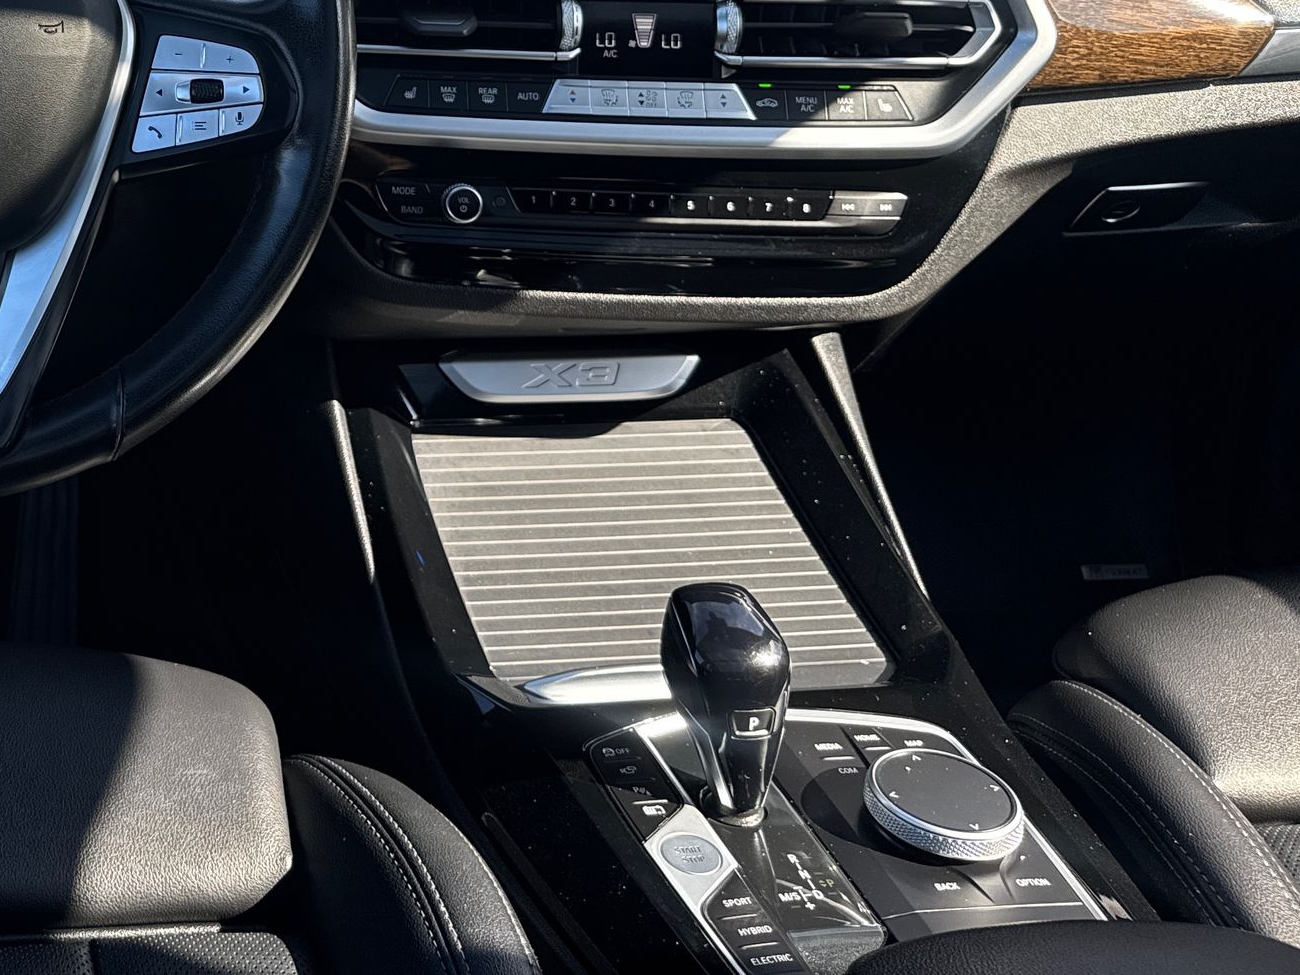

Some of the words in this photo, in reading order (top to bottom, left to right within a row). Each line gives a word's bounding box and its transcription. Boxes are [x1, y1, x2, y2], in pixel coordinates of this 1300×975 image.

[595, 32, 615, 47] LO
[661, 33, 681, 49] LO
[603, 49, 618, 58] A/C
[440, 85, 457, 94] MAX
[478, 87, 498, 95] REAR
[517, 91, 540, 101] AUTO
[795, 96, 818, 105] MENU
[836, 97, 854, 105] MAX
[800, 104, 816, 113] A/C
[839, 105, 854, 114] A/C
[392, 186, 416, 195] MODE
[457, 196, 470, 204] VOL
[570, 197, 577, 206] 2
[608, 198, 615, 207] 3
[649, 199, 656, 208] 4
[687, 200, 696, 210] 5
[726, 201, 736, 211] 6
[765, 202, 773, 212] 7
[802, 203, 811, 213] 8
[401, 205, 424, 215] BAND
[522, 361, 621, 388] X3
[749, 716, 760, 731] P
[854, 733, 881, 742] HOME
[814, 742, 843, 751] MEDIA
[904, 739, 923, 747] MAP
[615, 747, 630, 755] OFF
[838, 767, 859, 775] COM
[674, 844, 702, 854] START
[681, 855, 705, 864] STOP
[787, 853, 800, 863] R
[798, 869, 812, 880] N
[934, 881, 960, 891] BACK
[1015, 878, 1051, 887] OPTION
[778, 892, 801, 902] M/S
[812, 889, 824, 900] D
[722, 896, 752, 908] SPORT
[737, 925, 773, 937] HYBRID
[750, 953, 794, 966] ELECTRIC
